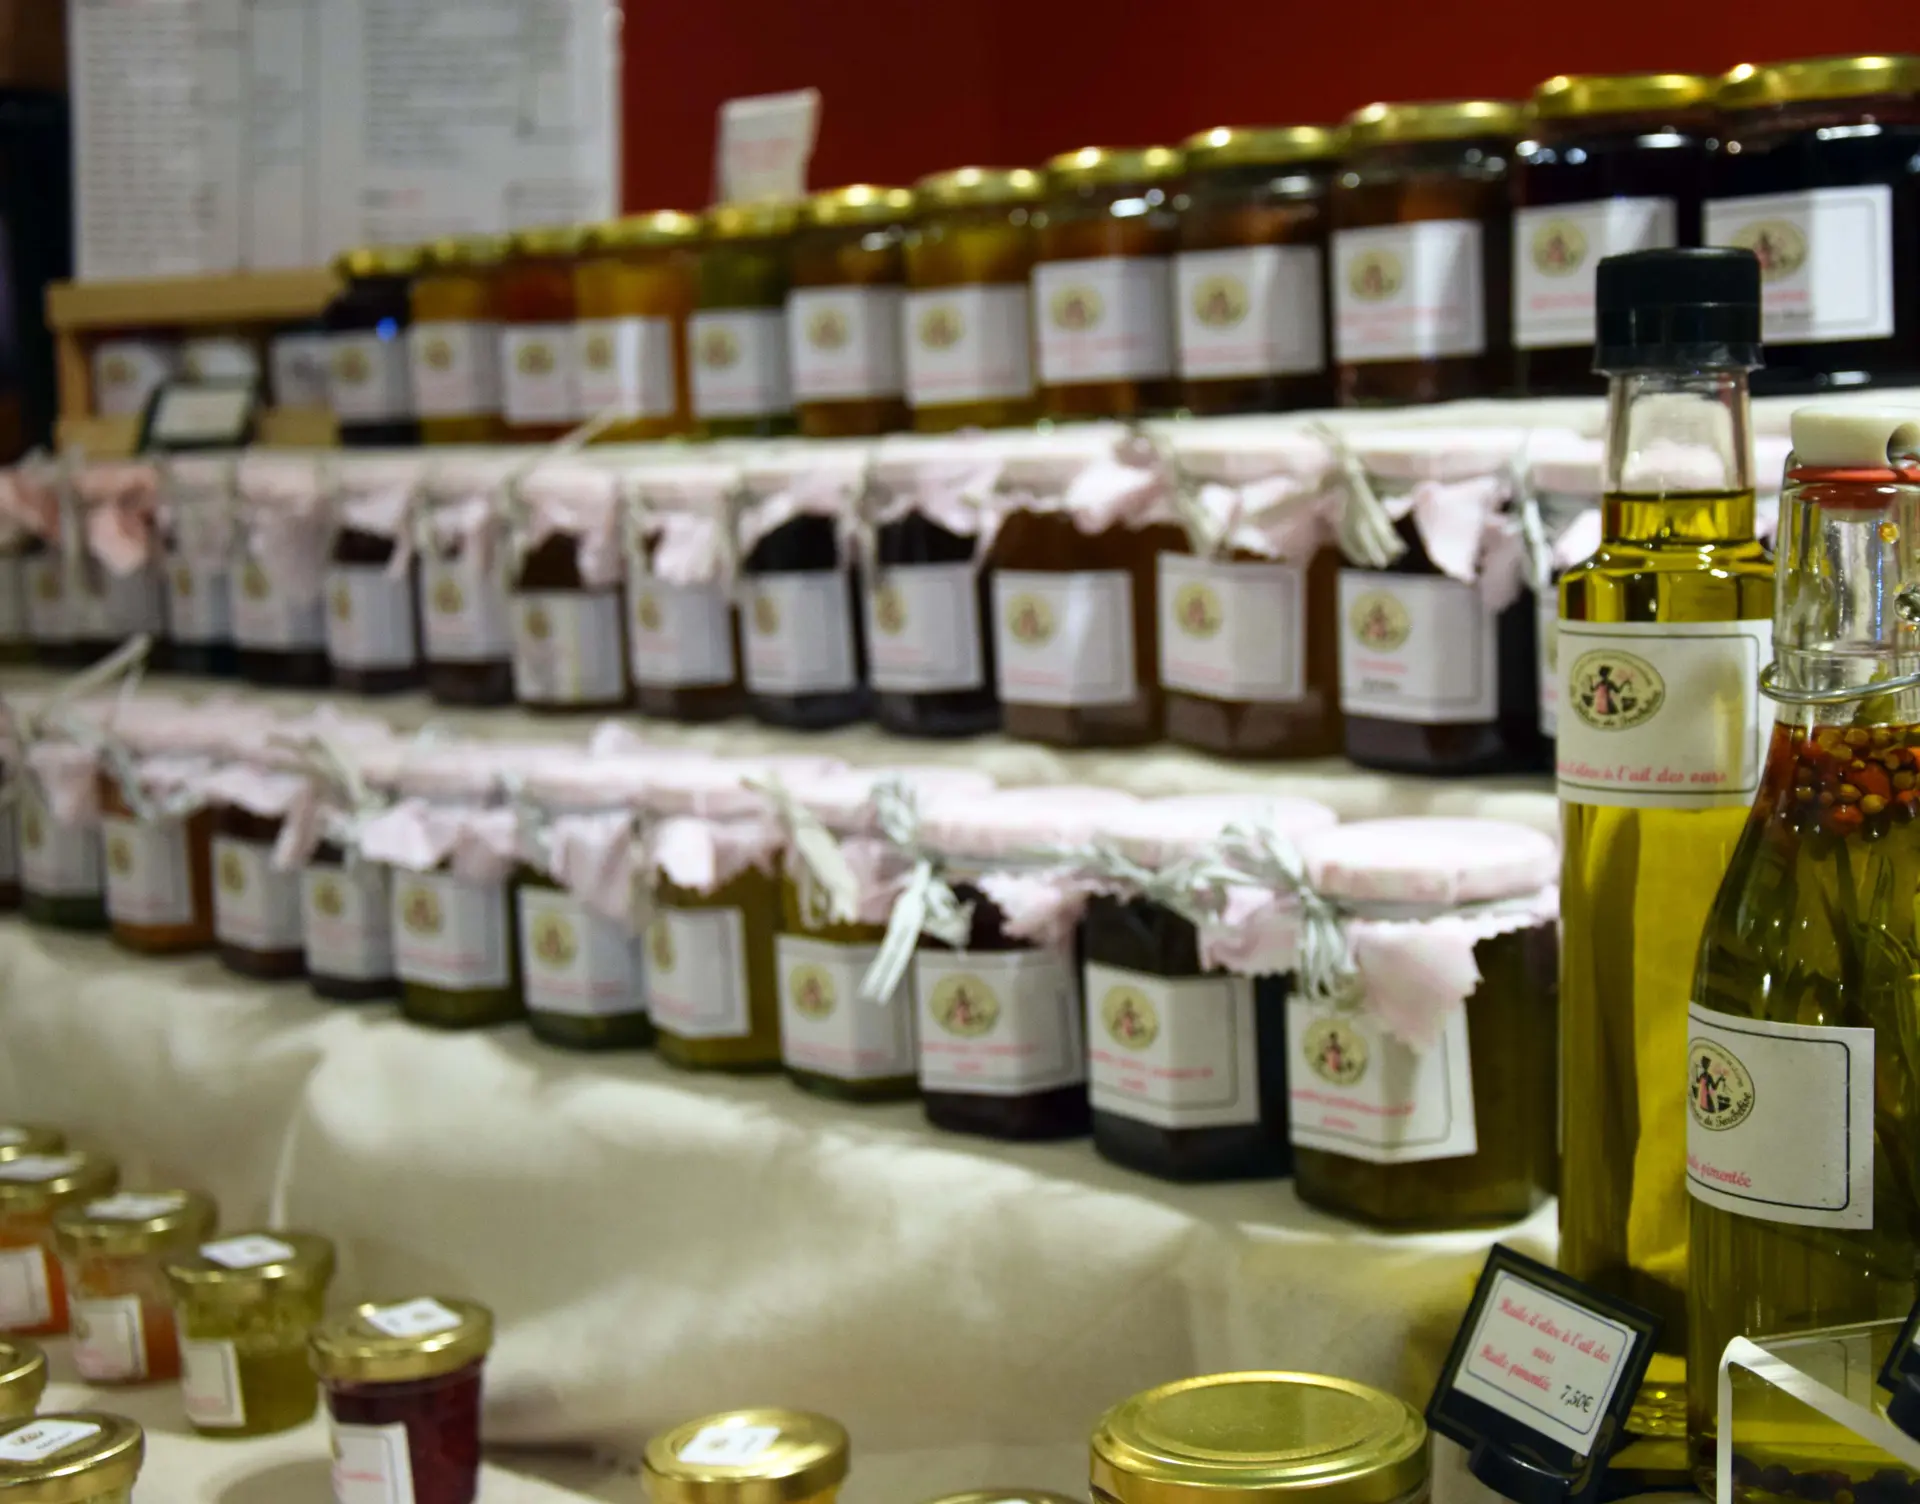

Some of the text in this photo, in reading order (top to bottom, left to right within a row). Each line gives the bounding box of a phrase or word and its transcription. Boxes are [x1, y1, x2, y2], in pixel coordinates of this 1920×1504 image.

[1655, 767, 1685, 783] des
[1700, 1161, 1753, 1188] pimentée
[1499, 1297, 1528, 1323] Huile
[1593, 1344, 1611, 1364] des
[1479, 1344, 1552, 1393] Huile pimentée
[1560, 1384, 1594, 1414] 7,50€
